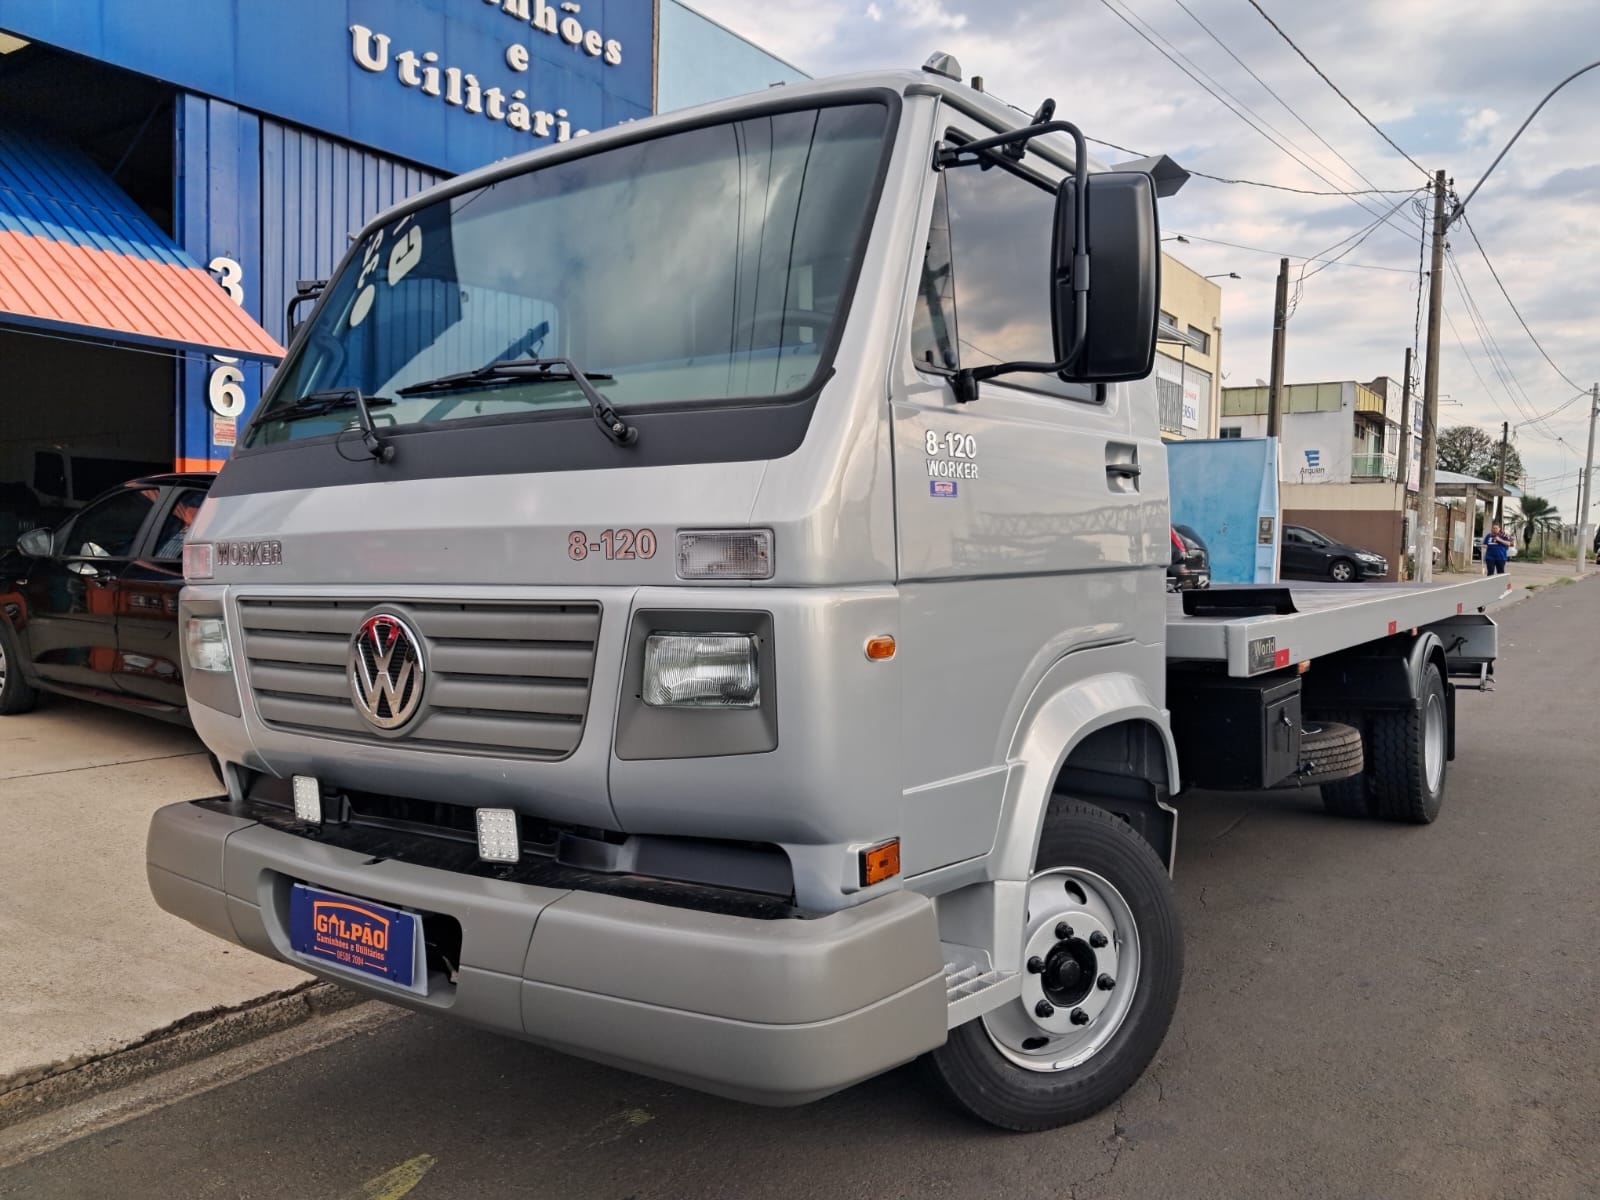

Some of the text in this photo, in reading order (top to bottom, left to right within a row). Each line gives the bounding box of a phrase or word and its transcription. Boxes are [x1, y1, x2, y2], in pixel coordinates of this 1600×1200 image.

[480, 0, 622, 65] nhões
[506, 43, 529, 72] e
[349, 25, 592, 143] Utilitári
[925, 430, 977, 459] 8-120
[926, 459, 979, 480] WORKER
[216, 540, 282, 566] WORKER
[567, 528, 657, 561] 8-120
[1254, 639, 1275, 656] World
[317, 914, 384, 949] GALPÃO
